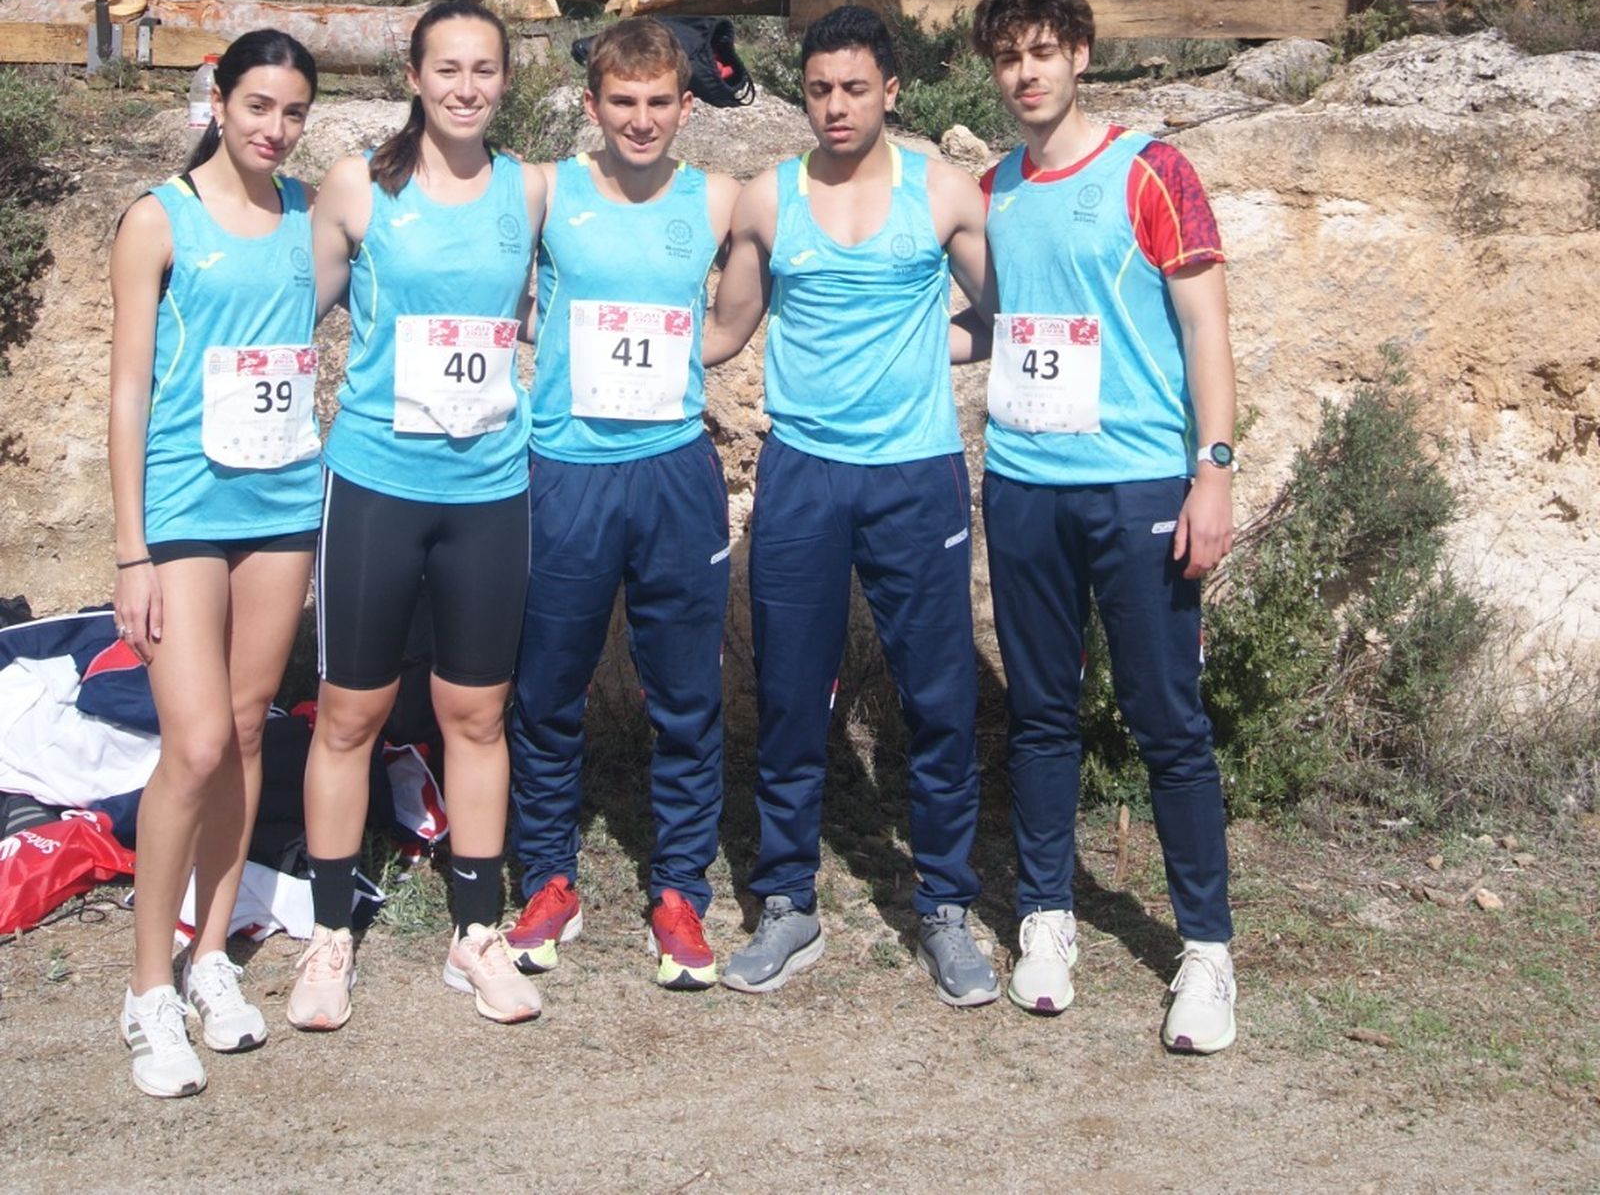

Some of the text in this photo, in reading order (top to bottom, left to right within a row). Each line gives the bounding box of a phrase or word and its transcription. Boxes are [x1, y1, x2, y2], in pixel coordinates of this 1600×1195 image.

[443, 352, 487, 384] 40
[611, 337, 653, 368] 41
[1022, 349, 1060, 380] 43
[254, 380, 293, 413] 39
